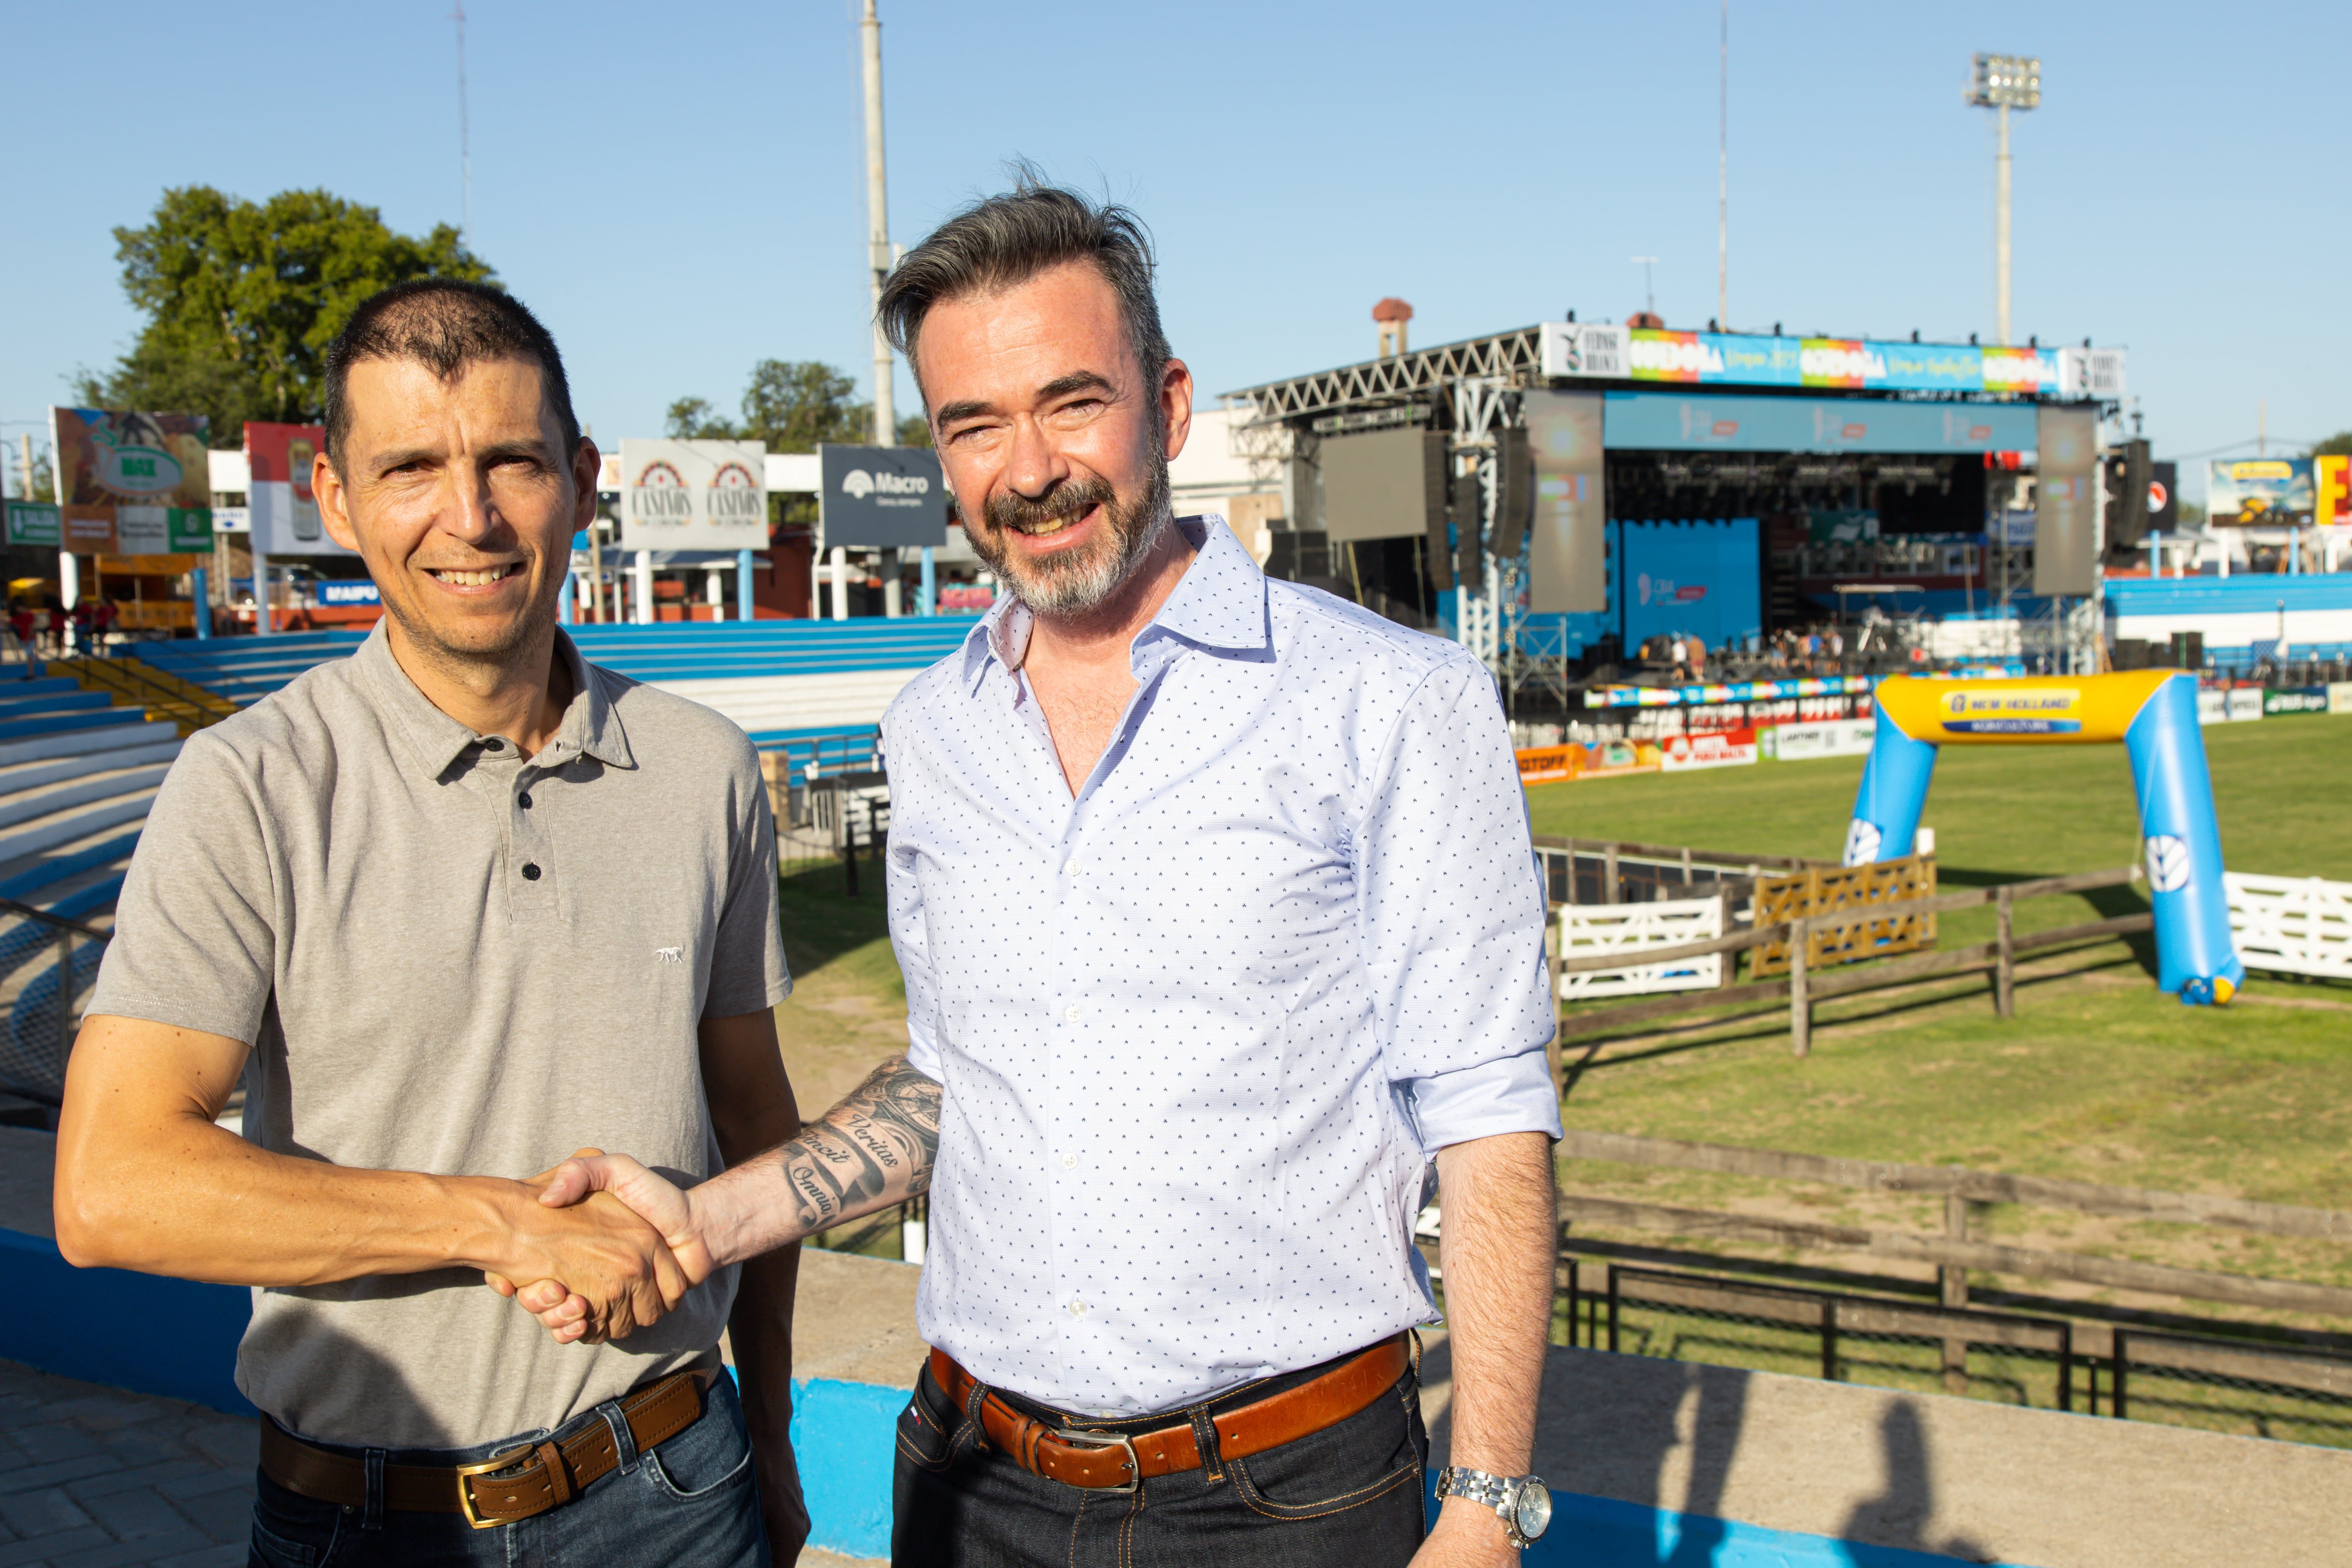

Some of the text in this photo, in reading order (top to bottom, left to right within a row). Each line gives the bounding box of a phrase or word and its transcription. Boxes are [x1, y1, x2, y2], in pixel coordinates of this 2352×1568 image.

[875, 472, 929, 494] Macro
[1972, 697, 2071, 709] NEW HOLLAND
[803, 1131, 851, 1164] Vincit
[847, 1113, 899, 1168] Veritas
[793, 1167, 836, 1215] Omnia
